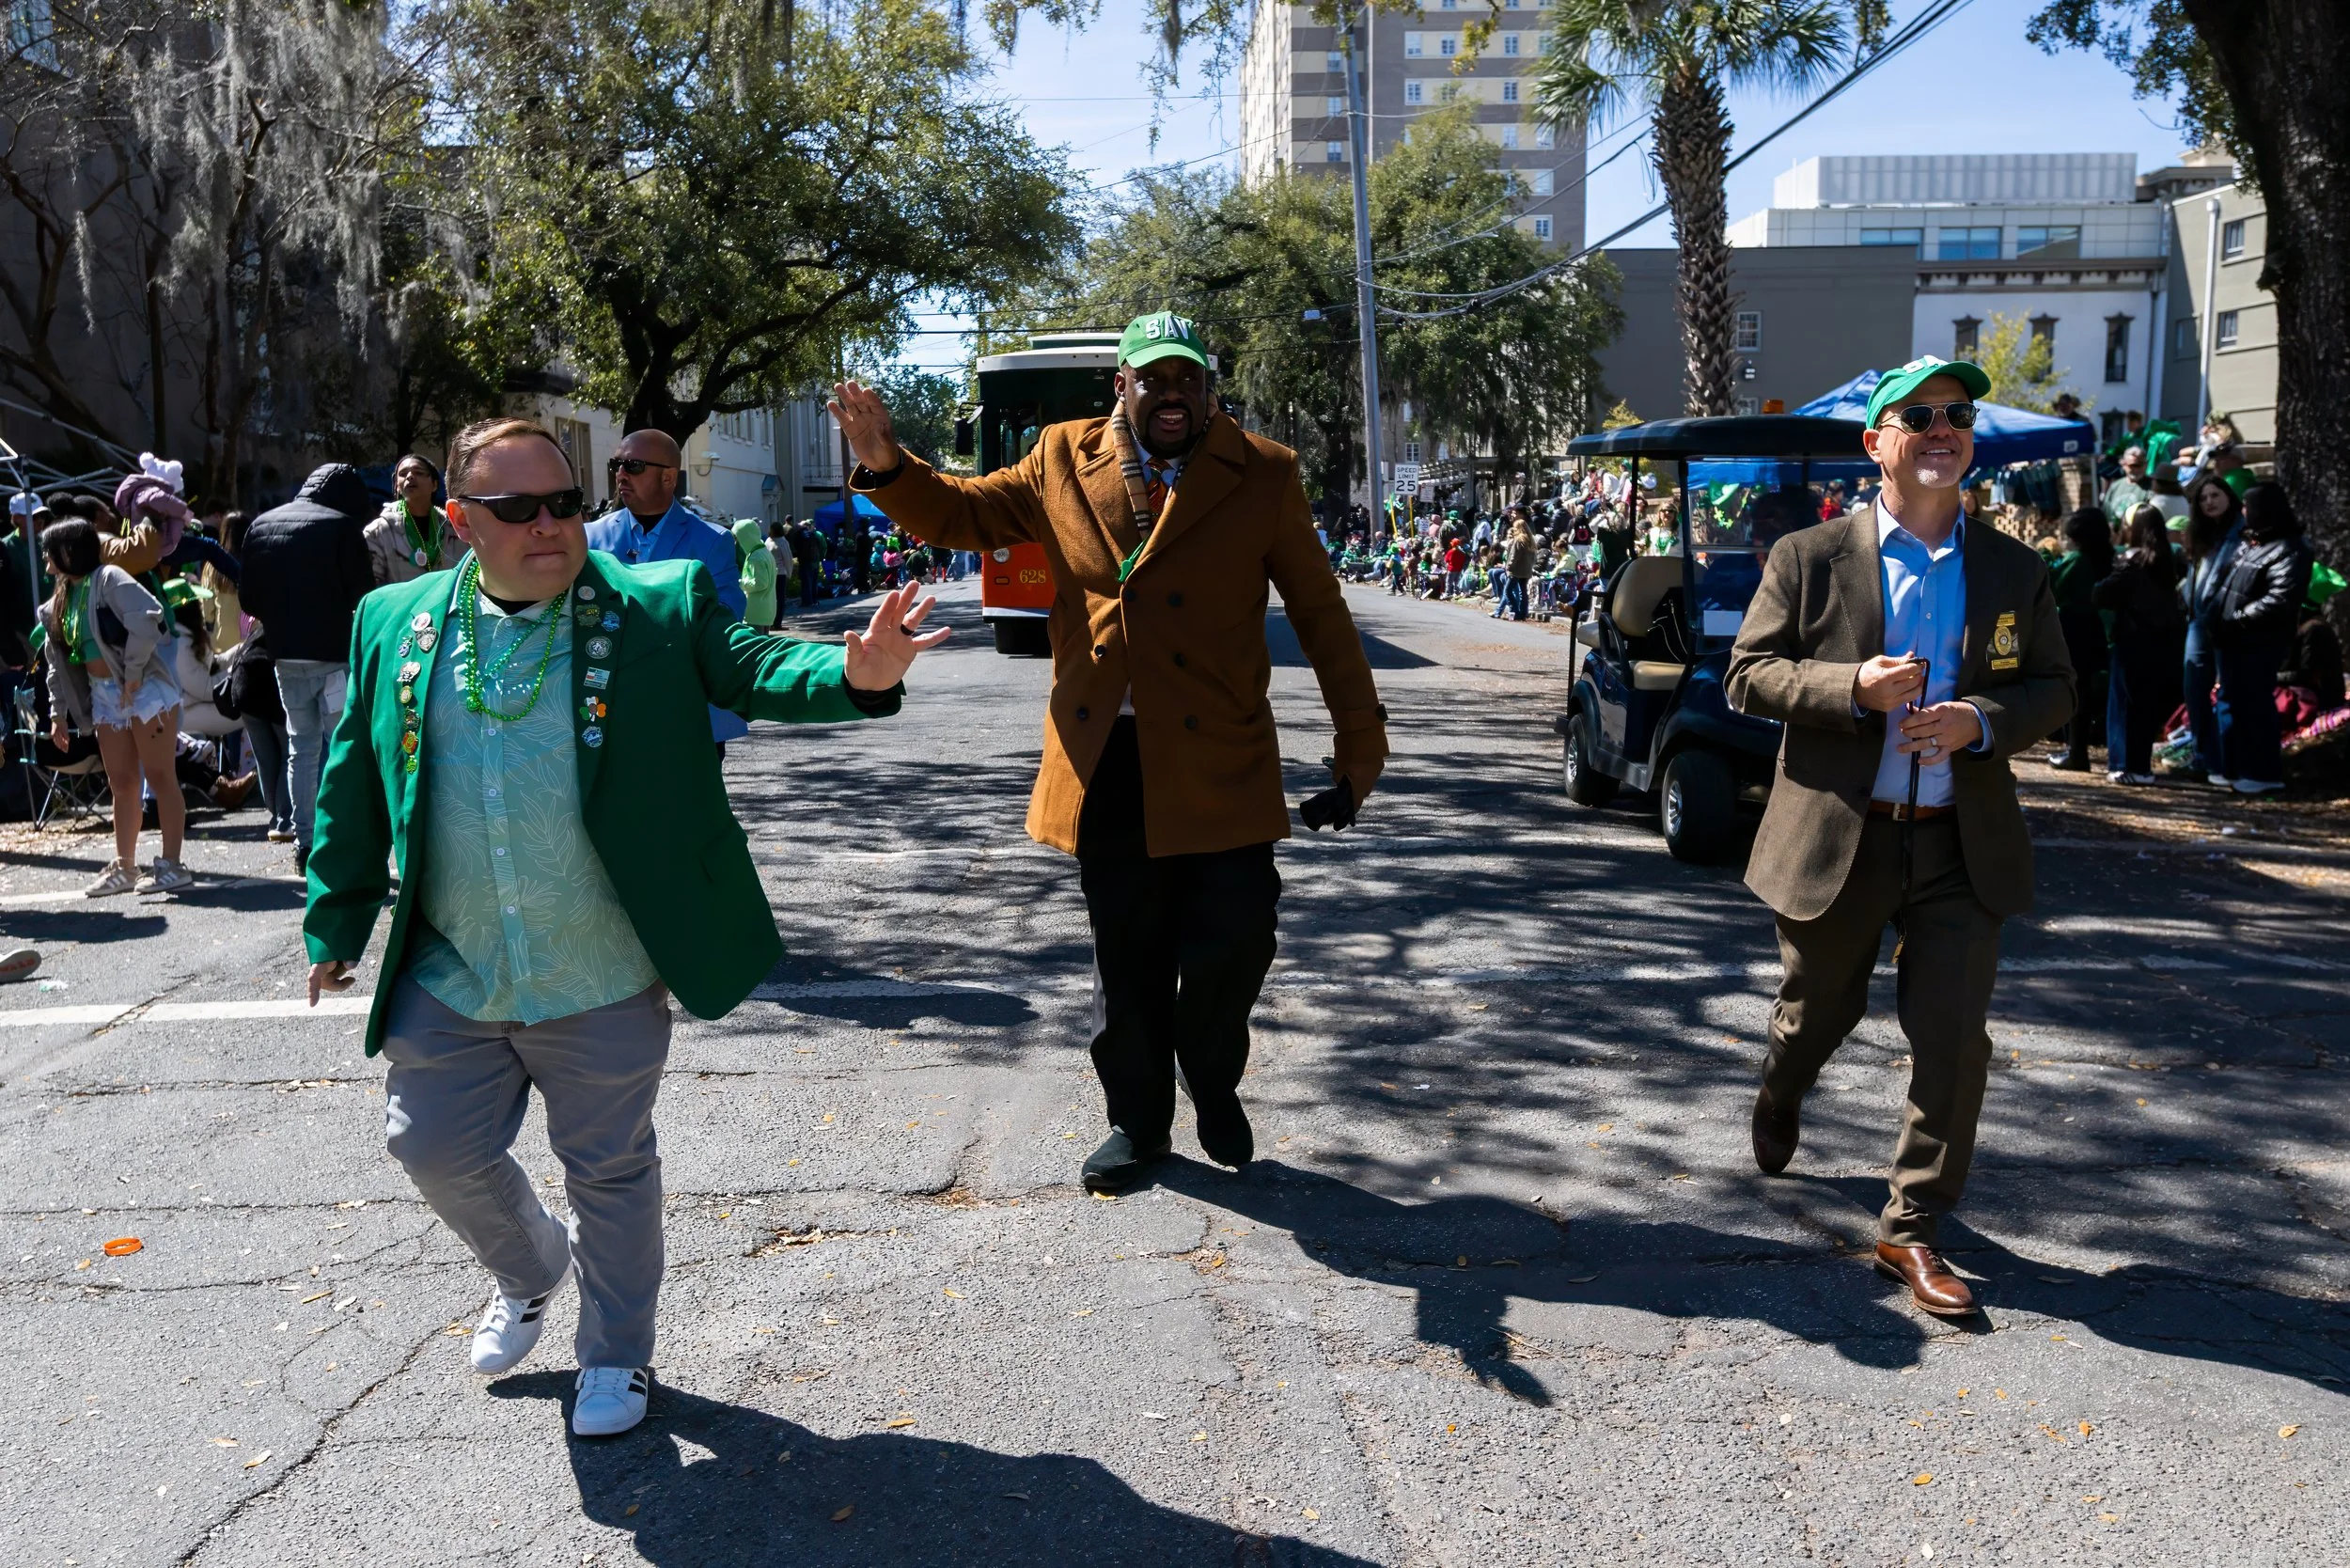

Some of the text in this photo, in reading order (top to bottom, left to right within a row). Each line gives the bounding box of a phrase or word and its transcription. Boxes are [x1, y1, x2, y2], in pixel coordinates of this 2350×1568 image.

[1145, 315, 1189, 339] SAV
[1396, 480, 1416, 492] 25
[1019, 569, 1046, 584] 628
